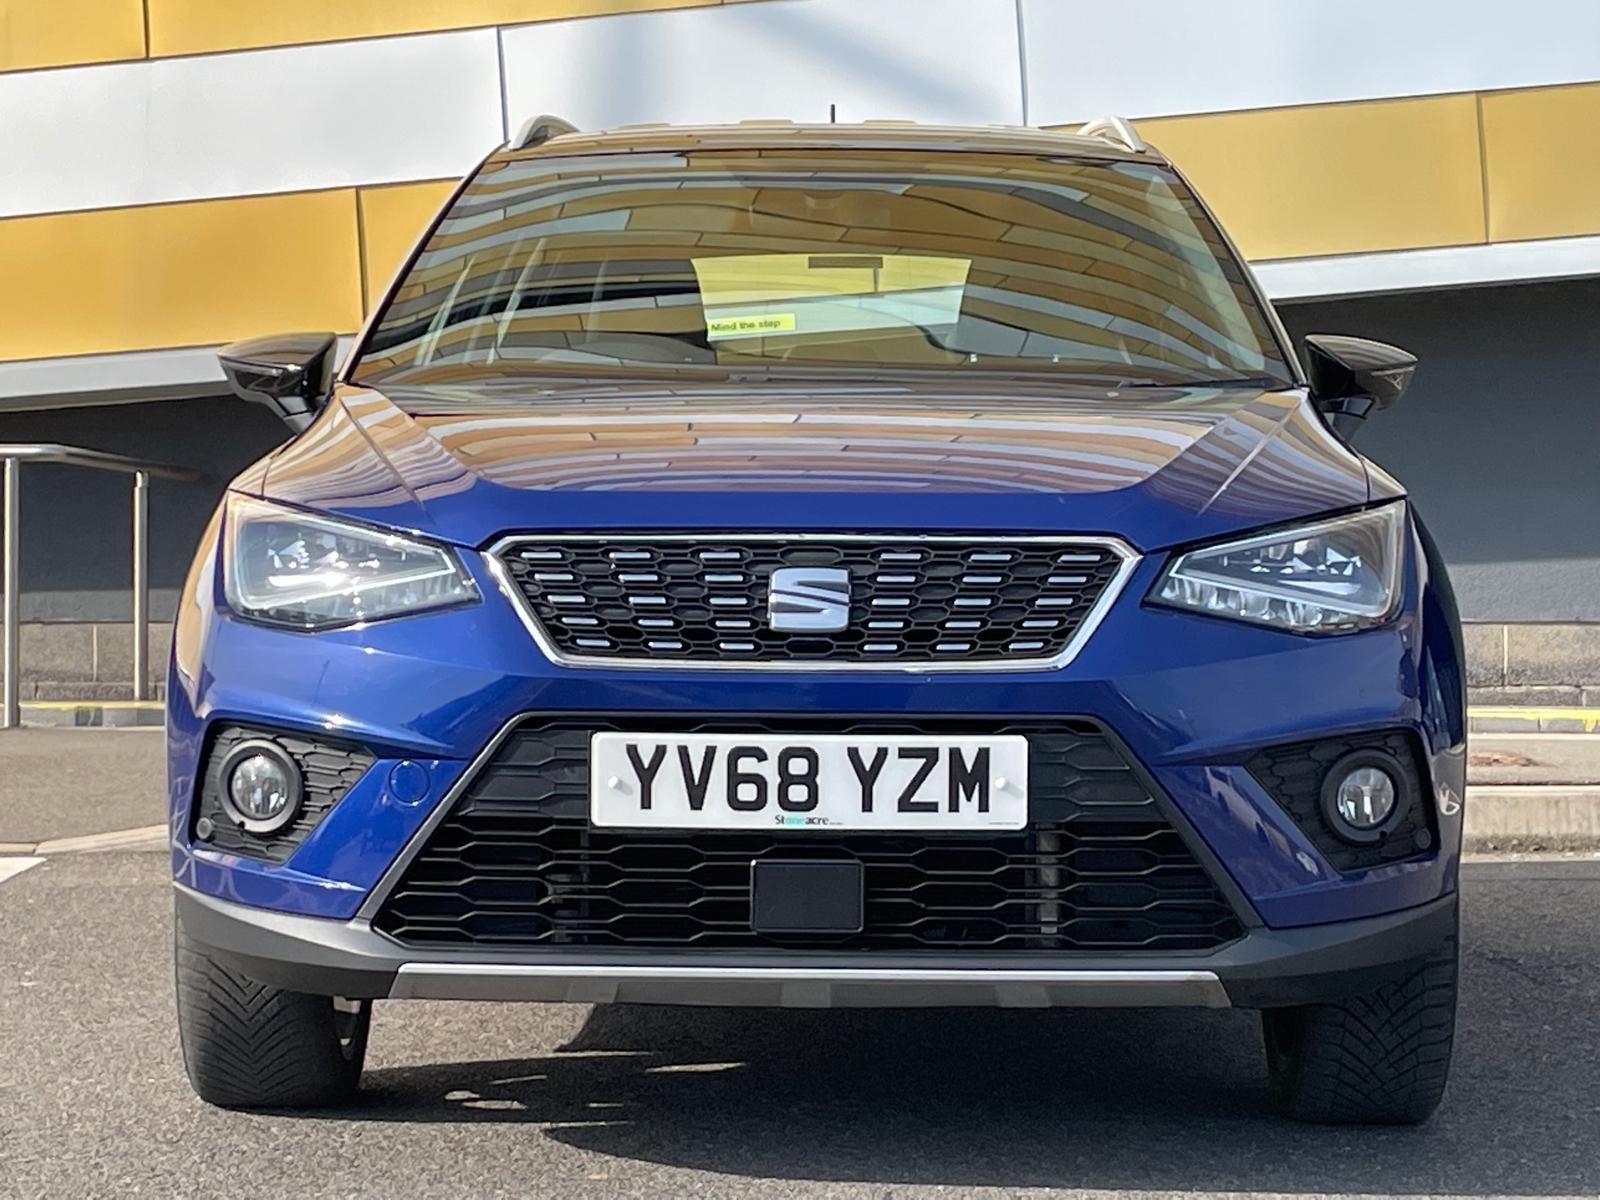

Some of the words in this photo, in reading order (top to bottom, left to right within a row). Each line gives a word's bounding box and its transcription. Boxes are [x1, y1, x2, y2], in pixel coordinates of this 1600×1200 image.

[711, 322, 736, 332] Mind
[739, 320, 756, 329] the
[758, 319, 781, 329] step
[625, 744, 820, 812] YV68
[846, 746, 991, 813] YZM
[774, 814, 830, 826] Stoneacre
